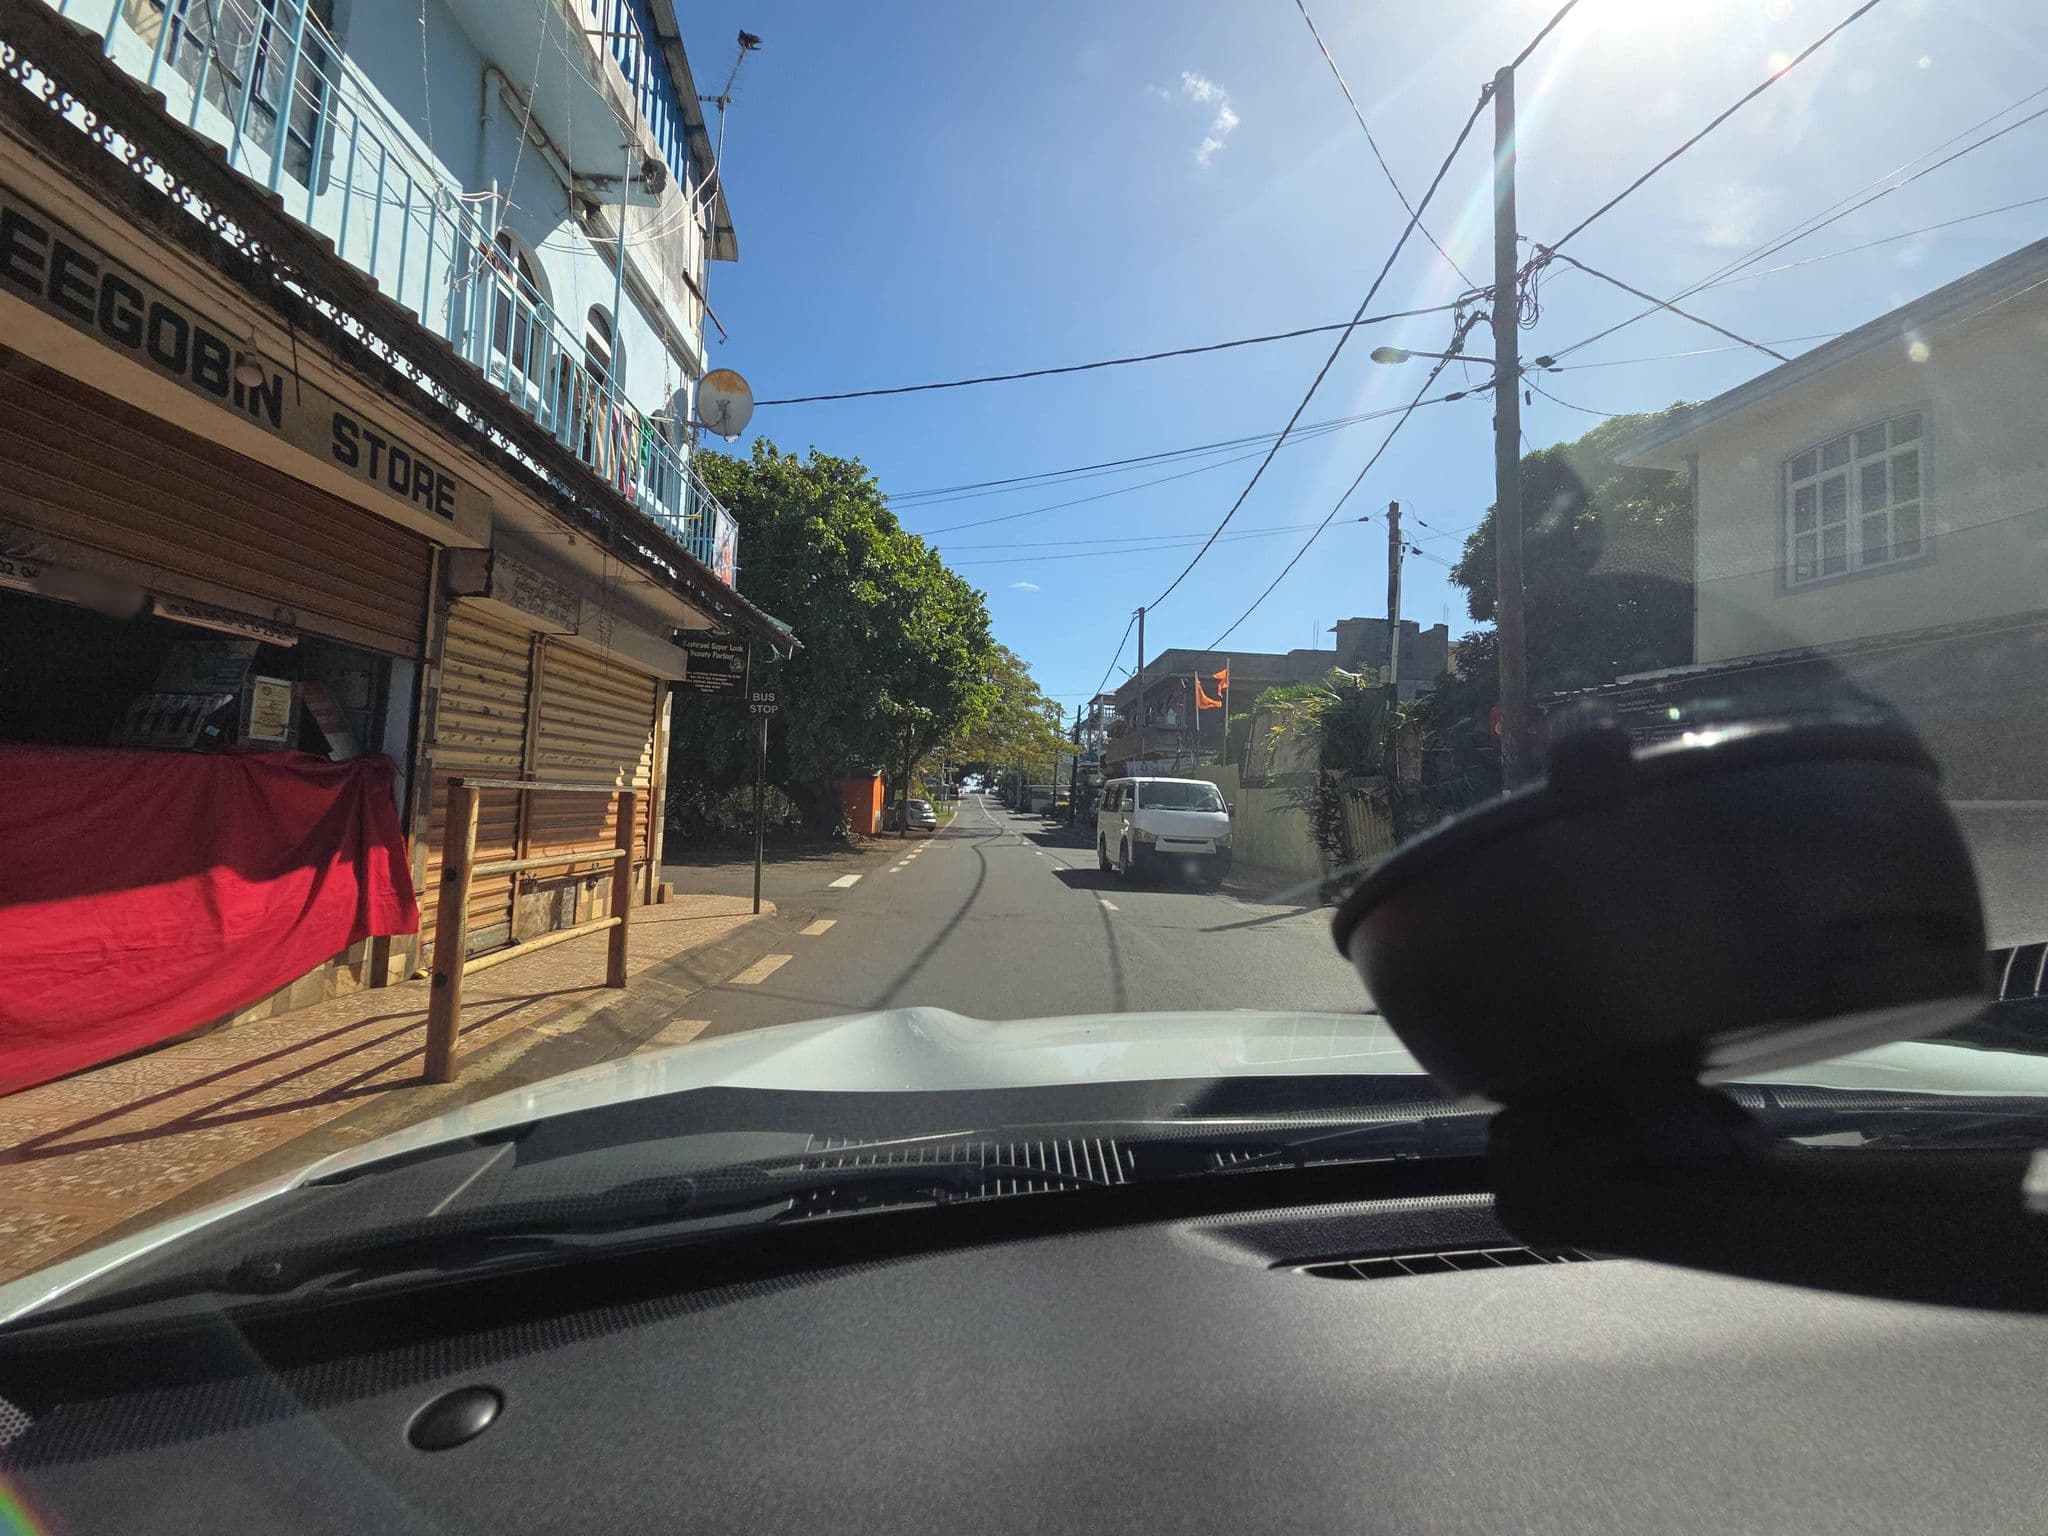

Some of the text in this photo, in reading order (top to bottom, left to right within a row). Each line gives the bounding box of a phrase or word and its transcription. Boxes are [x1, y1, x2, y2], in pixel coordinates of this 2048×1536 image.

[331, 412, 457, 521] STORE
[730, 643, 744, 653] Look
[752, 692, 775, 702] BUS
[750, 704, 778, 713] STOP
